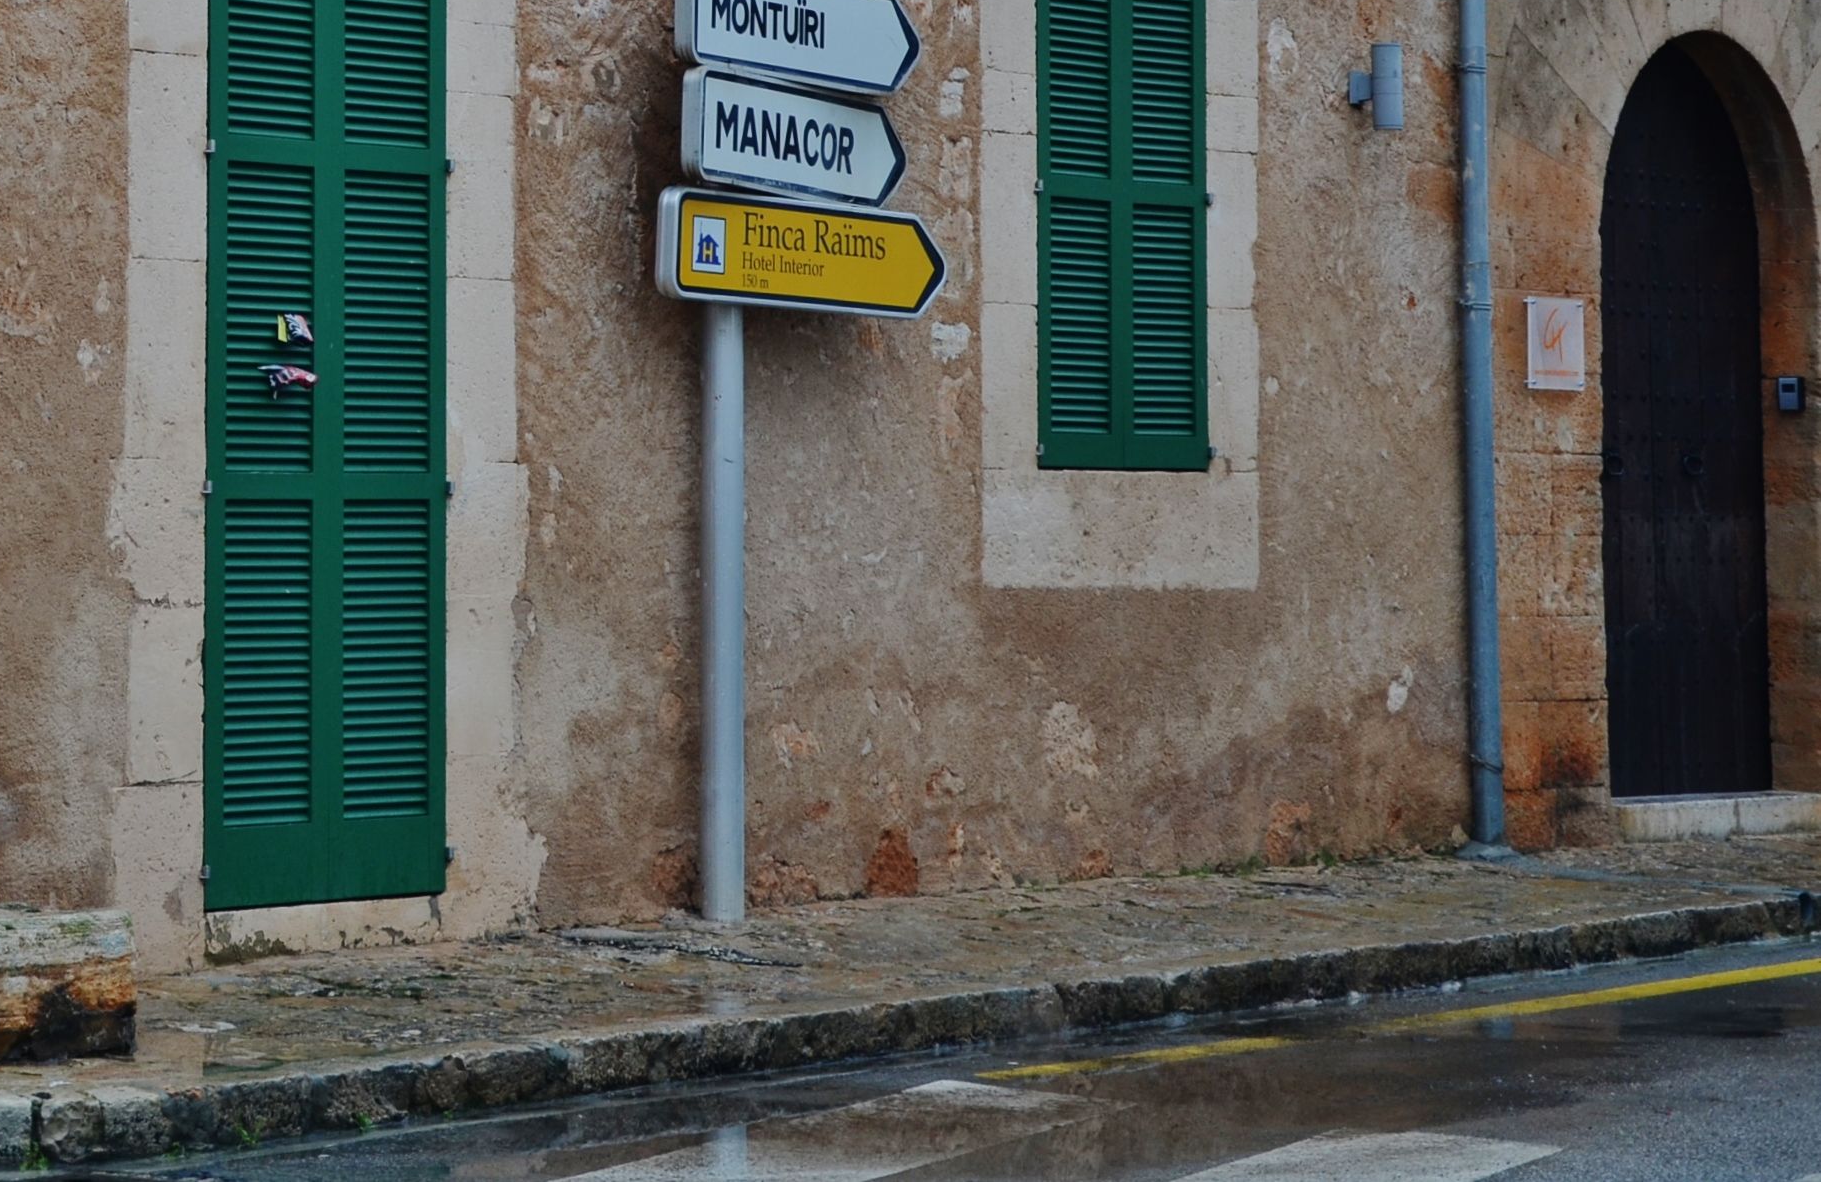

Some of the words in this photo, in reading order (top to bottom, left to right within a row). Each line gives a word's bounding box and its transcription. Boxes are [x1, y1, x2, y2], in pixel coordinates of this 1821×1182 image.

[715, 101, 855, 174] MANACOR
[743, 211, 807, 252] Finca
[813, 219, 886, 260] Raïms
[742, 251, 776, 273] Hotel
[779, 255, 825, 277] Interior
[742, 274, 758, 289] 150
[760, 280, 770, 290] m
